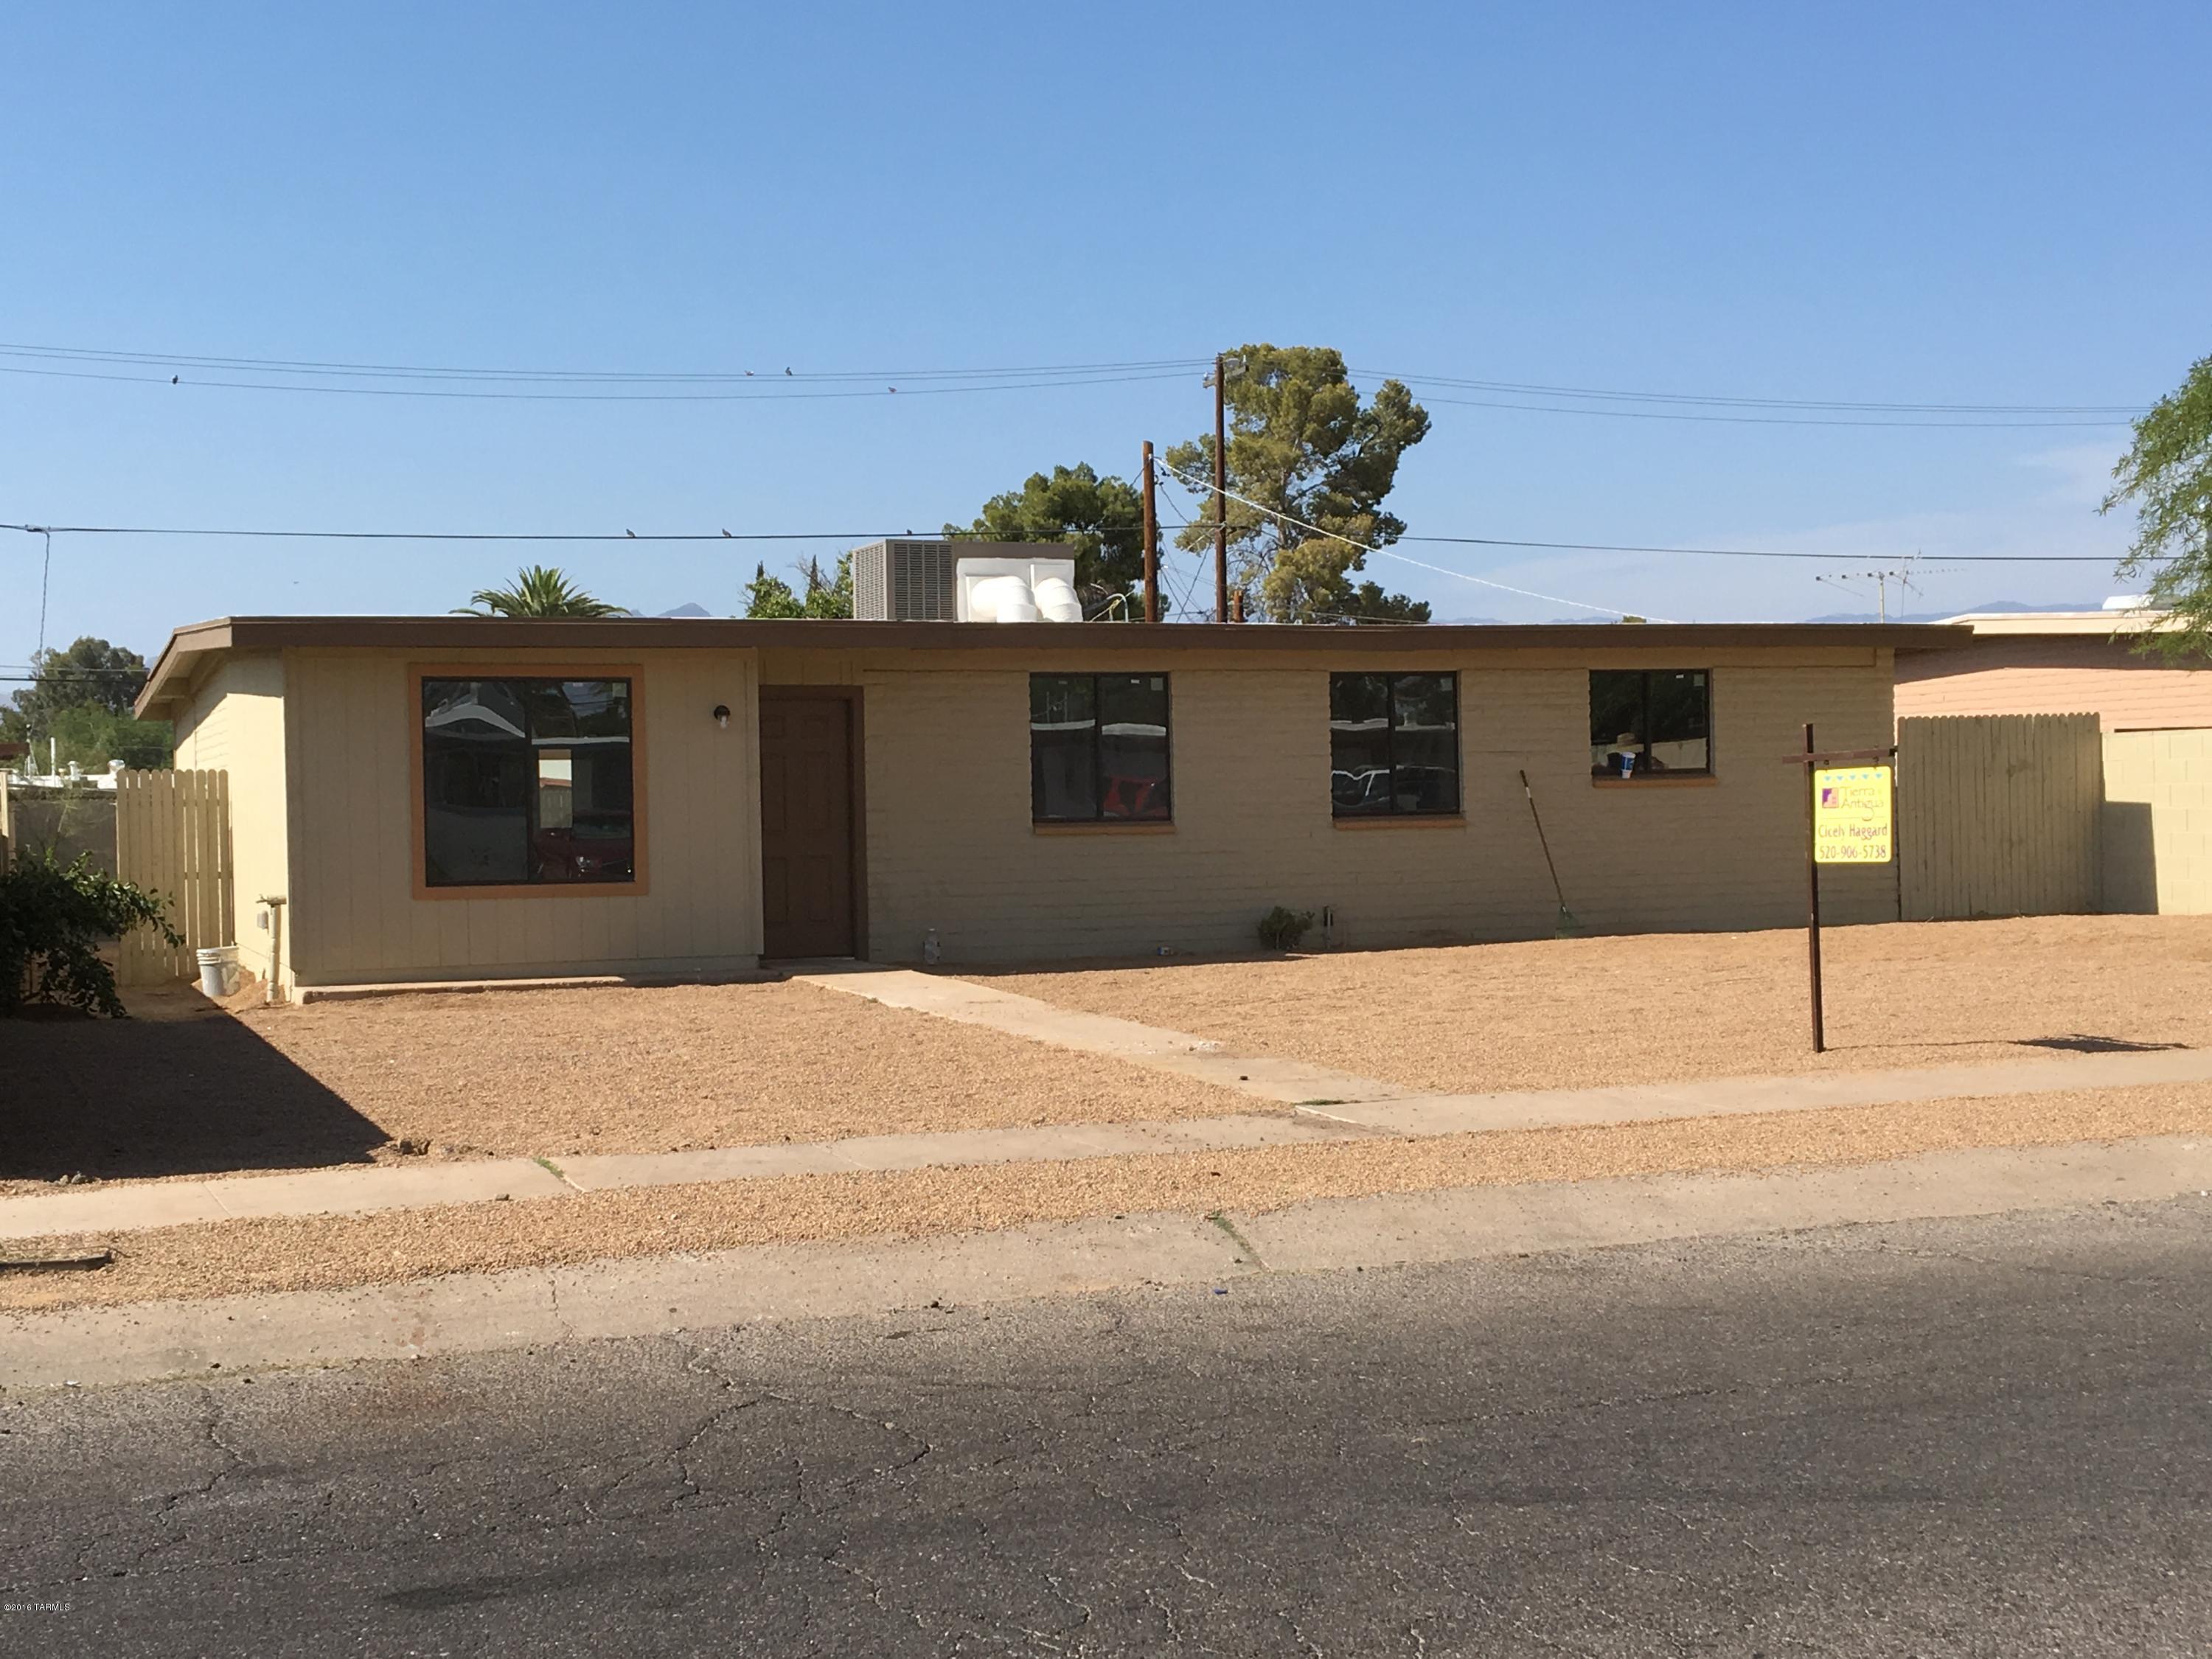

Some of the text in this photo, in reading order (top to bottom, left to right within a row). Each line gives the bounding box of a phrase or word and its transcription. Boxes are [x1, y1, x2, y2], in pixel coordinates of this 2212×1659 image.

[1840, 786, 1875, 796] Tierra
[1840, 799, 1884, 821] Antigua
[1818, 823, 1888, 841] Cicely Haggard
[1820, 845, 1886, 859] 520-906-5738
